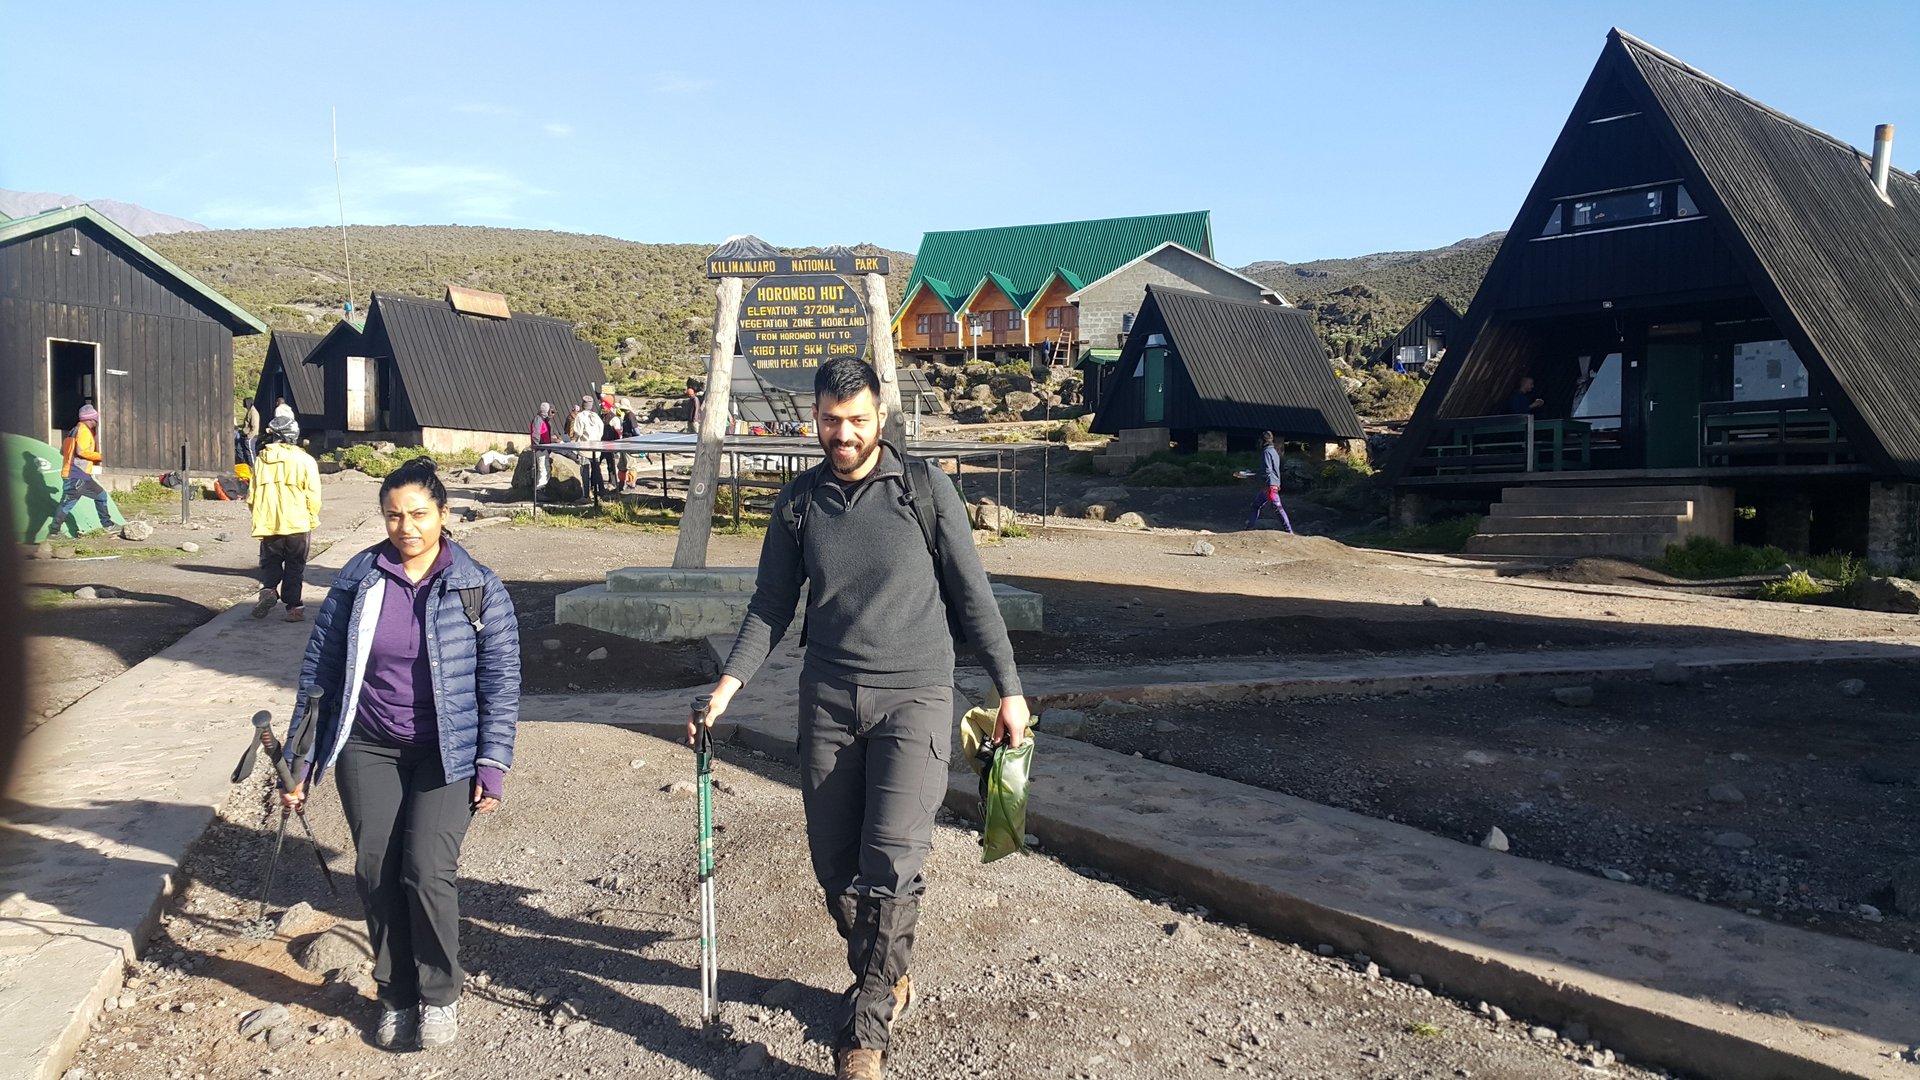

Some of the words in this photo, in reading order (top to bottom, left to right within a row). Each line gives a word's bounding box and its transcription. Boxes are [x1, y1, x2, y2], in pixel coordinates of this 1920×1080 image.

[711, 260, 776, 274] KILIMANJARO
[791, 259, 836, 272] NATIONAL
[855, 257, 879, 271] PARK
[757, 286, 816, 302] HOROMBO
[820, 285, 845, 300] HUT
[803, 305, 835, 315] 3720M
[740, 318, 788, 329] VEGETATION
[821, 317, 865, 327] MOORLAND
[756, 332, 778, 341] FROM
[780, 331, 816, 341] HOROMBO
[819, 331, 836, 340] HUT
[753, 345, 776, 356] KIBO
[804, 344, 823, 355] 9KM
[756, 359, 779, 369] UHURU
[802, 358, 819, 368] 15KM
